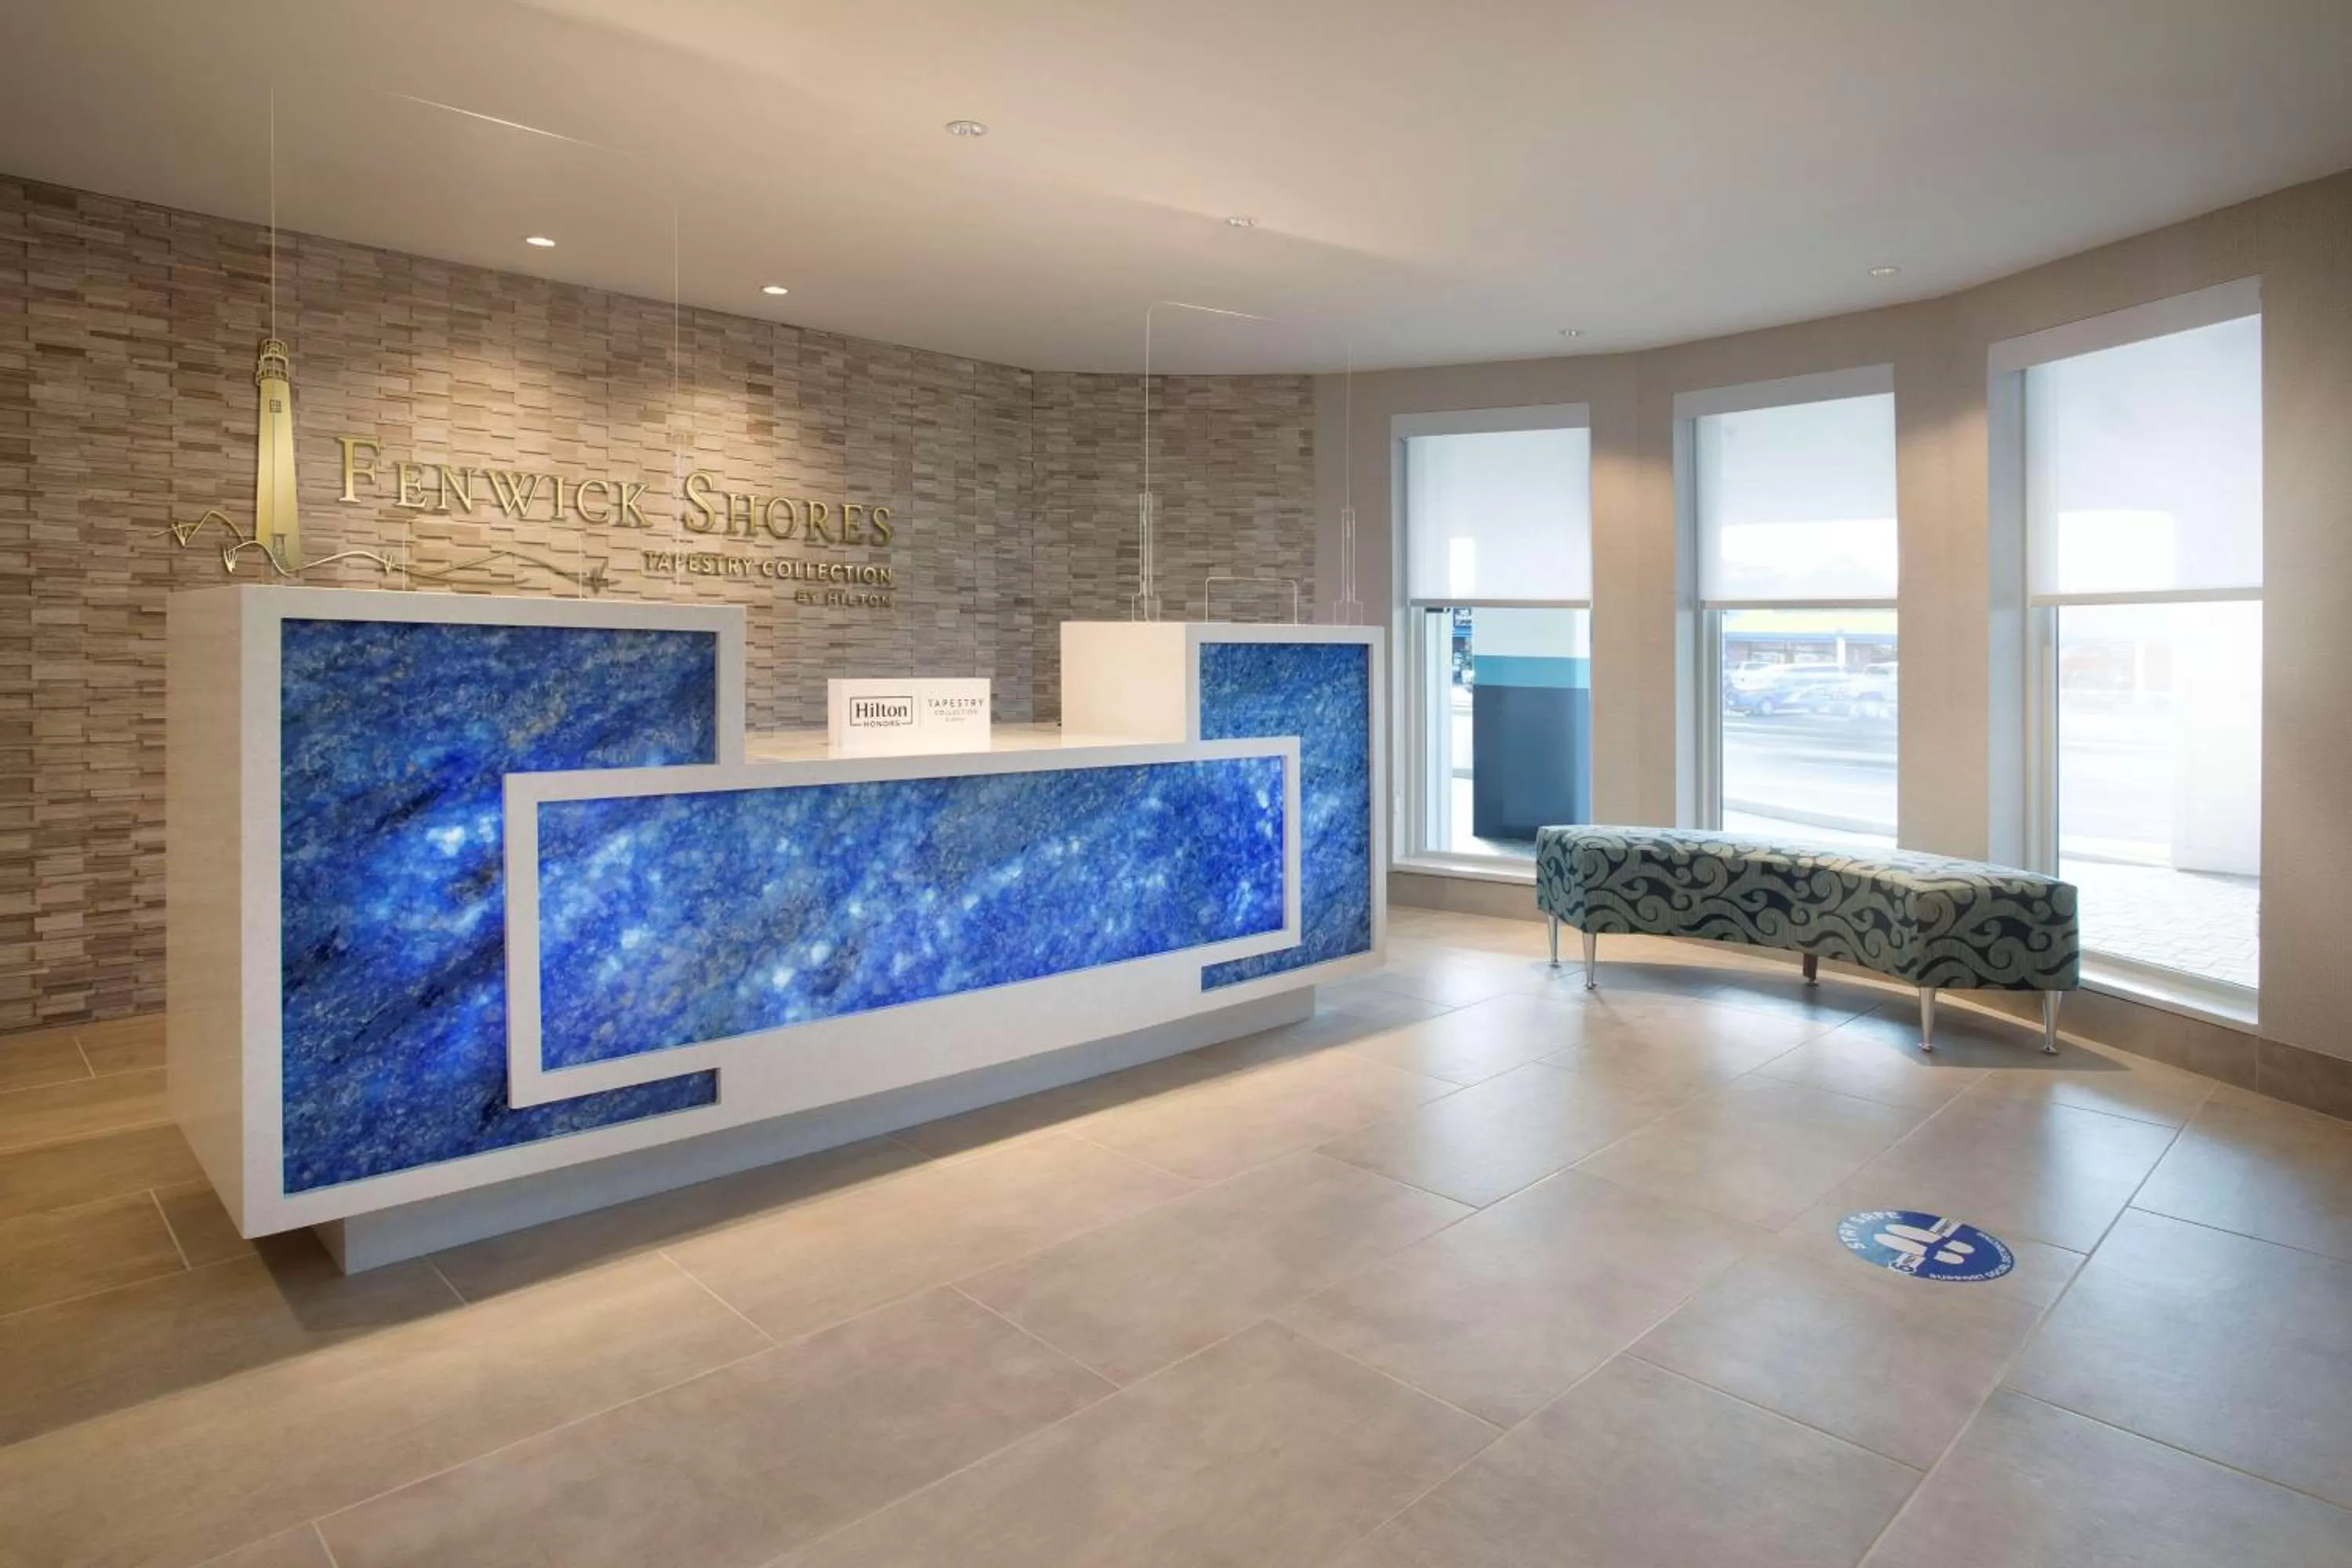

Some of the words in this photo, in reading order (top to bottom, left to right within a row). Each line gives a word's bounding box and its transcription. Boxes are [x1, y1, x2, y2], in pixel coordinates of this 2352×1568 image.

[338, 436, 653, 528] FENWICK
[683, 470, 894, 546] SHORES
[644, 551, 755, 577] TAPESTRY
[762, 557, 891, 584] COLLECTION
[855, 702, 908, 719] Hilton
[927, 699, 984, 707] TAPESTRY
[1838, 1222, 1867, 1250] STAY
